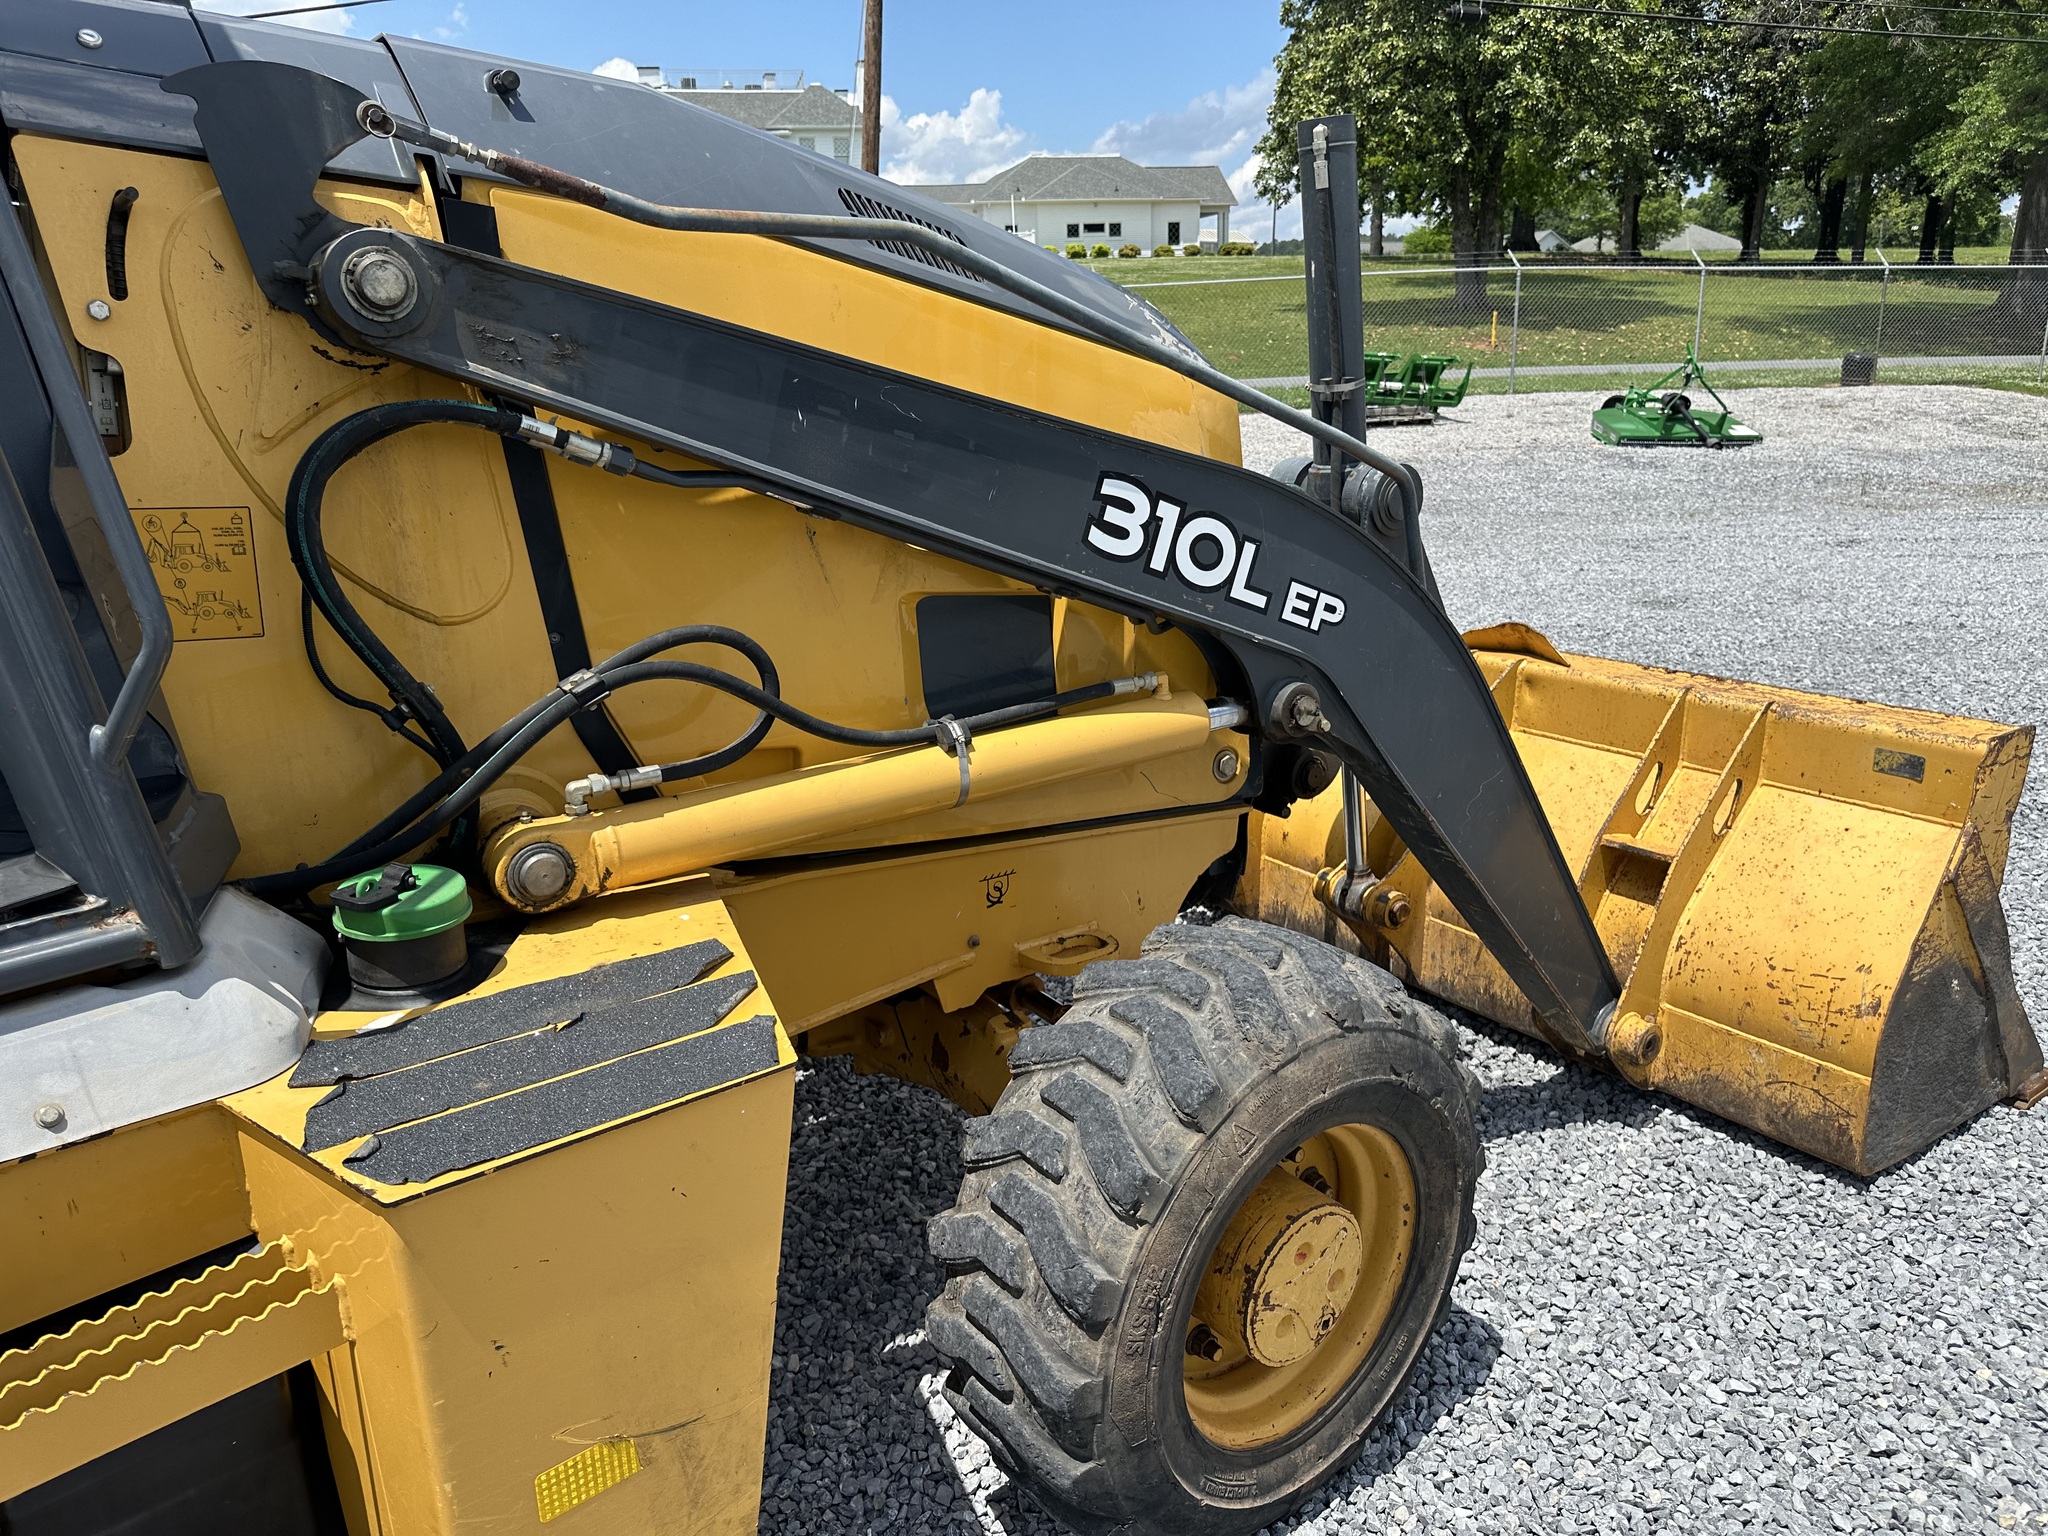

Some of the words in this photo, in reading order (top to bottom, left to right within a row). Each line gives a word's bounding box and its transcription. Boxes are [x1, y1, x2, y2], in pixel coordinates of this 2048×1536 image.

[1086, 477, 1269, 611] 310L
[1281, 580, 1347, 632] EP
[1245, 1082, 1283, 1117] WARNING
[1124, 1313, 1152, 1357] SKS
